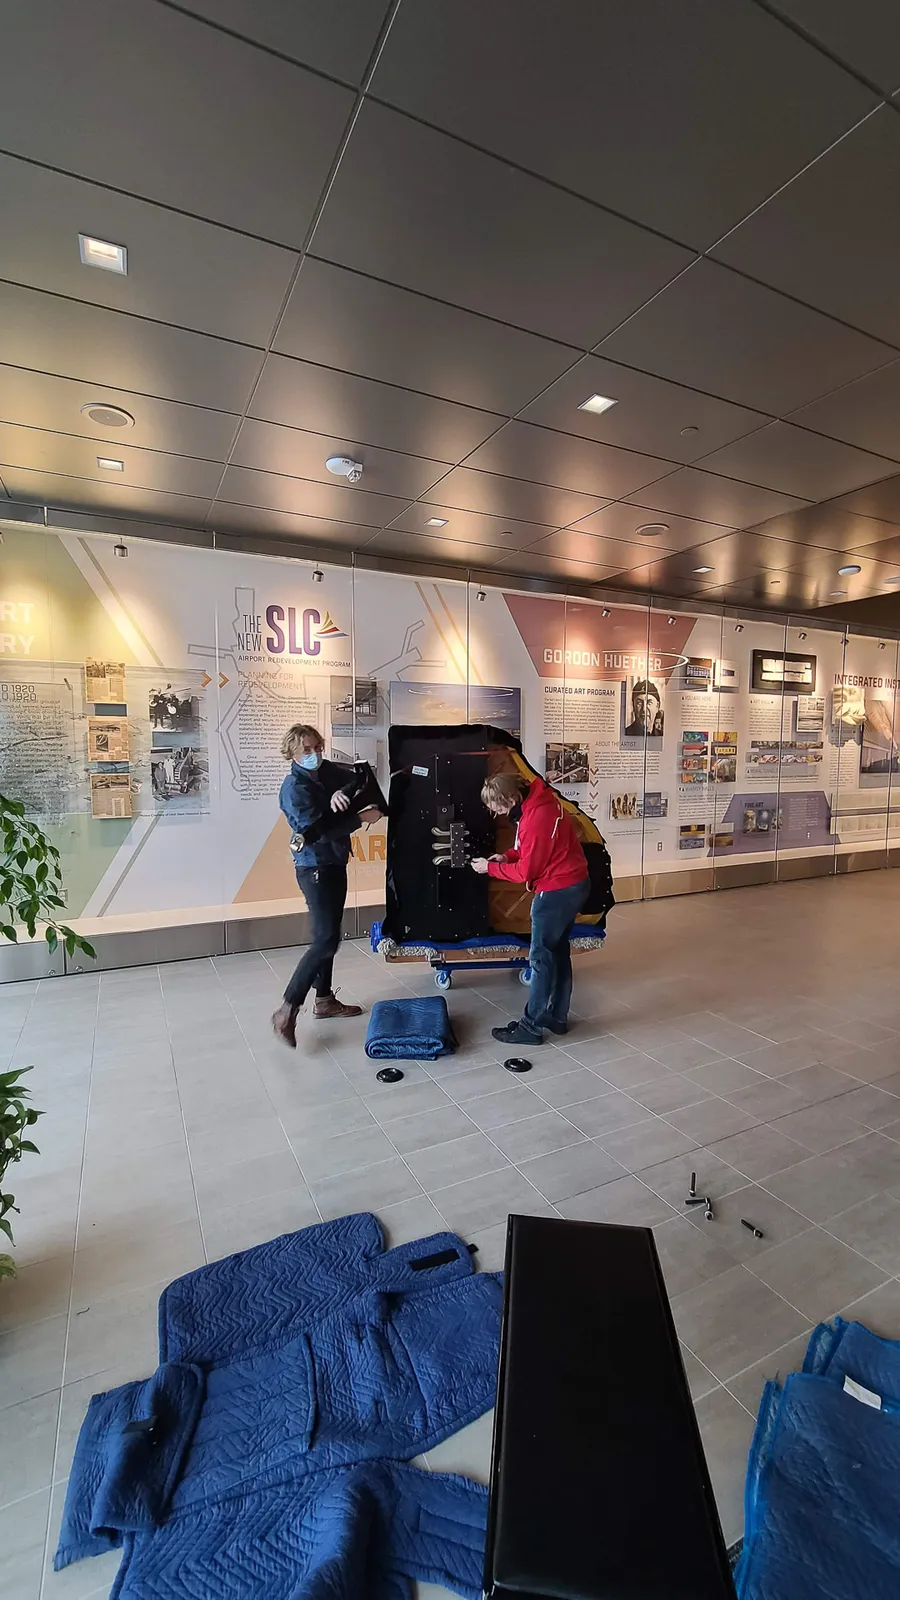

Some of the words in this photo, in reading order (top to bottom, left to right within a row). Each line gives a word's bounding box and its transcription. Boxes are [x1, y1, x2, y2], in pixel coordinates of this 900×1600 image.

[243, 614, 261, 633] THE
[266, 605, 320, 656] SLC
[238, 633, 262, 652] NEW
[268, 657, 320, 665] REDEVELOPMENT
[544, 648, 600, 666] GORDON
[604, 654, 662, 671] HUETHER
[238, 671, 278, 680] PLANNING
[834, 674, 883, 688] INTEGRATED
[544, 686, 572, 694] CURATED
